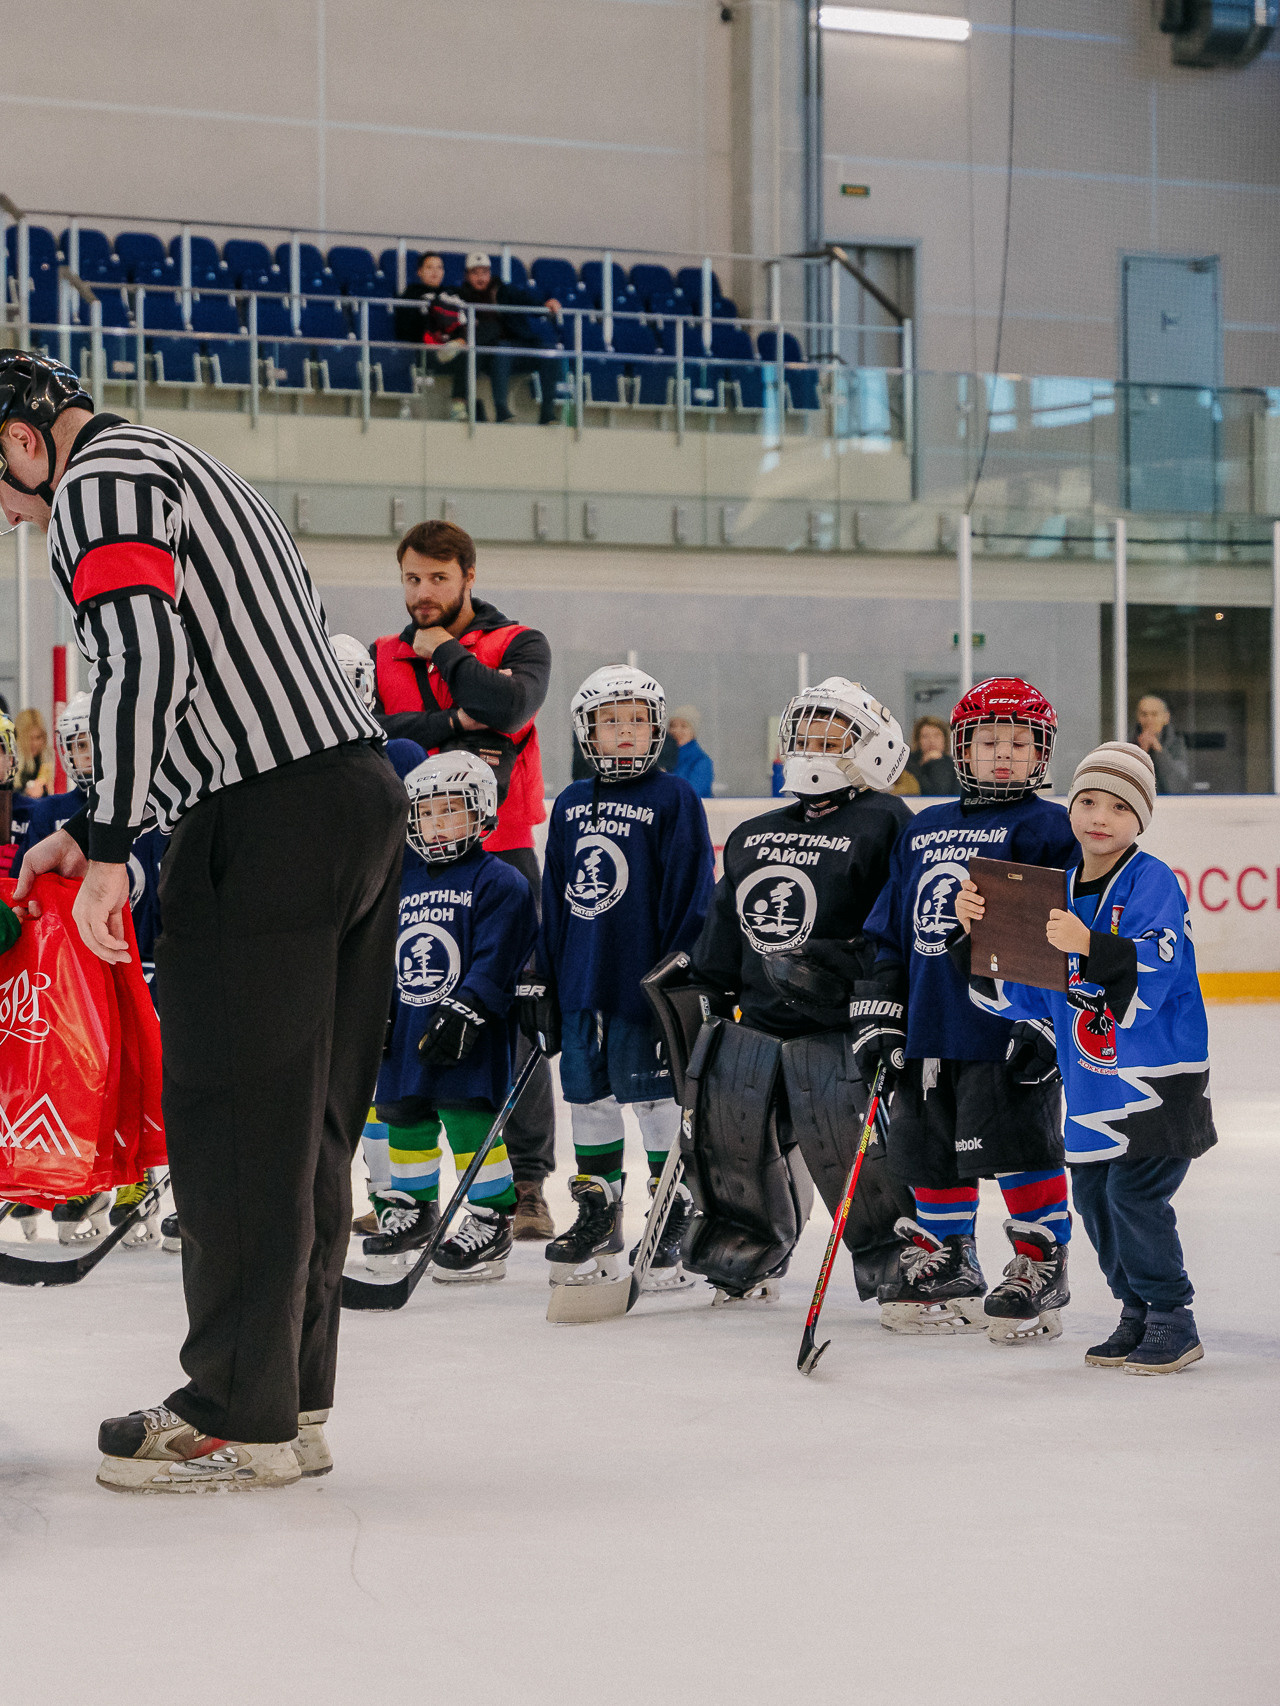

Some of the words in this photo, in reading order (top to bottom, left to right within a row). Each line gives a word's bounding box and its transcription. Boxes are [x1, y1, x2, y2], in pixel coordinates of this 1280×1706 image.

[988, 697, 1020, 705] CCM
[565, 801, 655, 825] УРОРТНЫЙ
[579, 816, 631, 837] РАЙОН
[743, 832, 852, 852] КУРОРТНЫЙ
[911, 827, 1008, 851] КУРОРТНЫЙ
[756, 847, 820, 866] РАЙОН
[922, 844, 980, 864] РАЙОН
[400, 906, 455, 926] РАЙОН
[440, 997, 486, 1026] CCM
